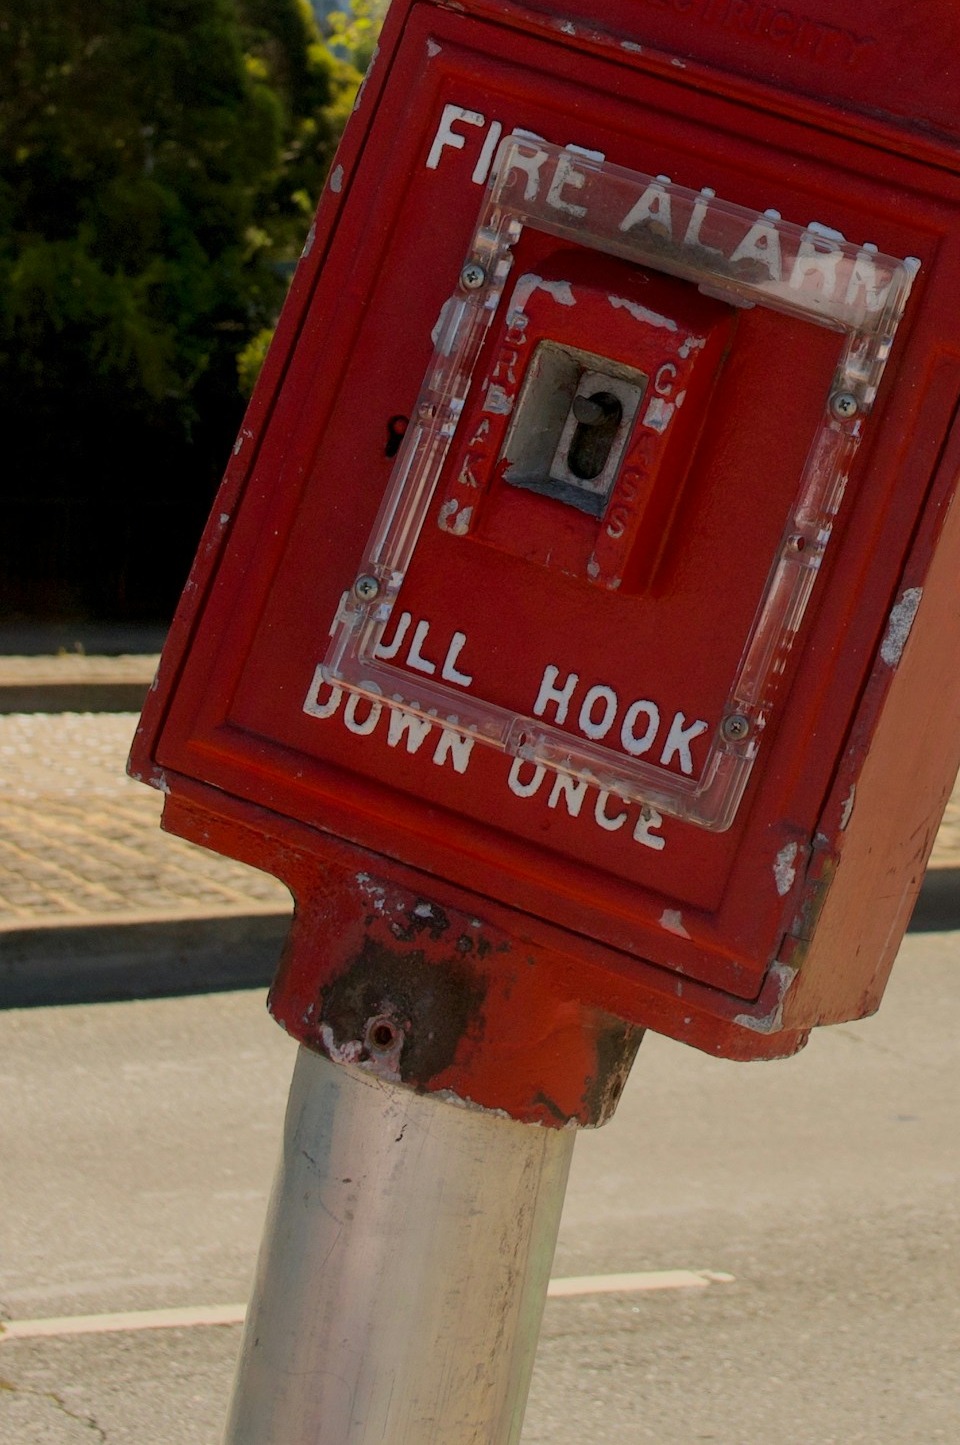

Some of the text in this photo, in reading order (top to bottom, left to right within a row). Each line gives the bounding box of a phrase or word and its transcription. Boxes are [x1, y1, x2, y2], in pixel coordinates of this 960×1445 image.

[426, 104, 921, 324] FIRE ALARM
[303, 663, 670, 851] DOWN ONCE
[532, 664, 709, 775] HOOK
